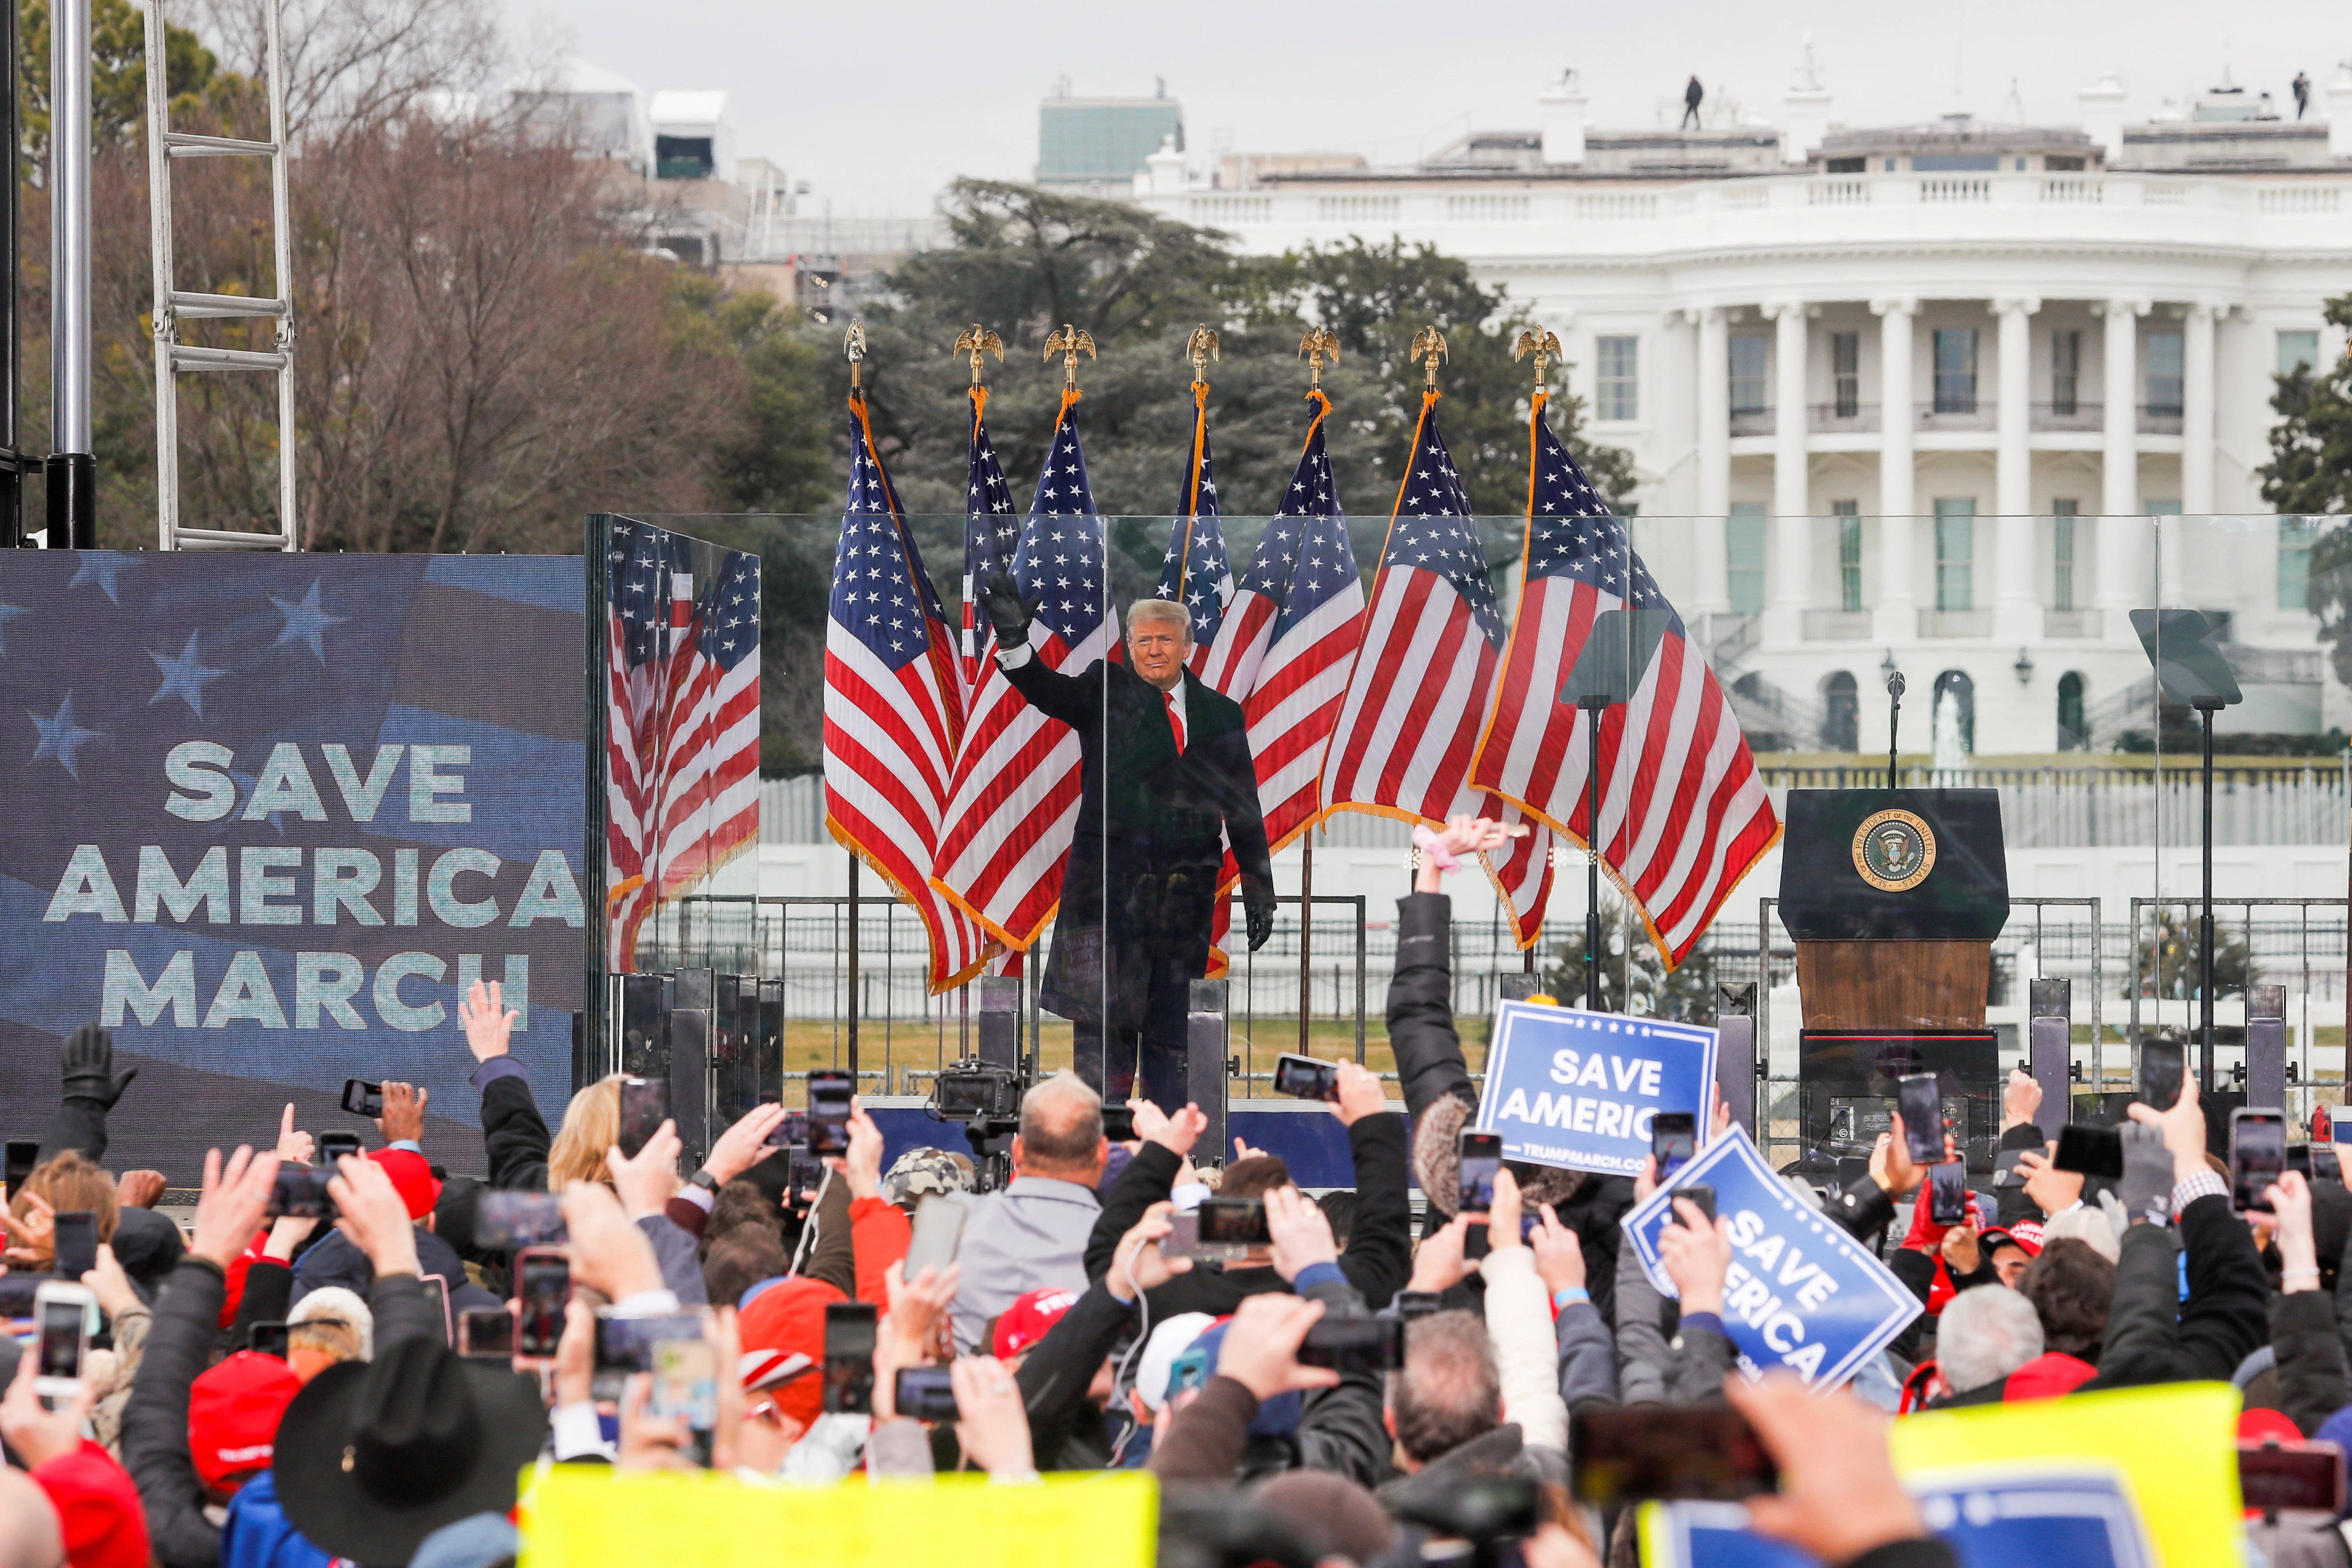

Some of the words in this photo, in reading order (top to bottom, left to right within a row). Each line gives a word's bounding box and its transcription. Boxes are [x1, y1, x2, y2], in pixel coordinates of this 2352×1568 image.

[164, 741, 472, 823] SAVE
[1856, 812, 1892, 849] PRESIDENT
[1903, 815, 1914, 823] THE
[1915, 821, 1933, 855] UNITED
[42, 844, 585, 928] AMERICA
[1865, 870, 1887, 888] SEAL
[1902, 862, 1930, 888] STATES
[99, 948, 530, 1032] MARCH
[1550, 1048, 1663, 1097] SAVE
[1497, 1087, 1662, 1142] AMERIC
[1523, 1142, 1647, 1172] TRUMPMARCH.CO
[1725, 1209, 1839, 1312] SAVE
[1724, 1261, 1827, 1384] ERICA
